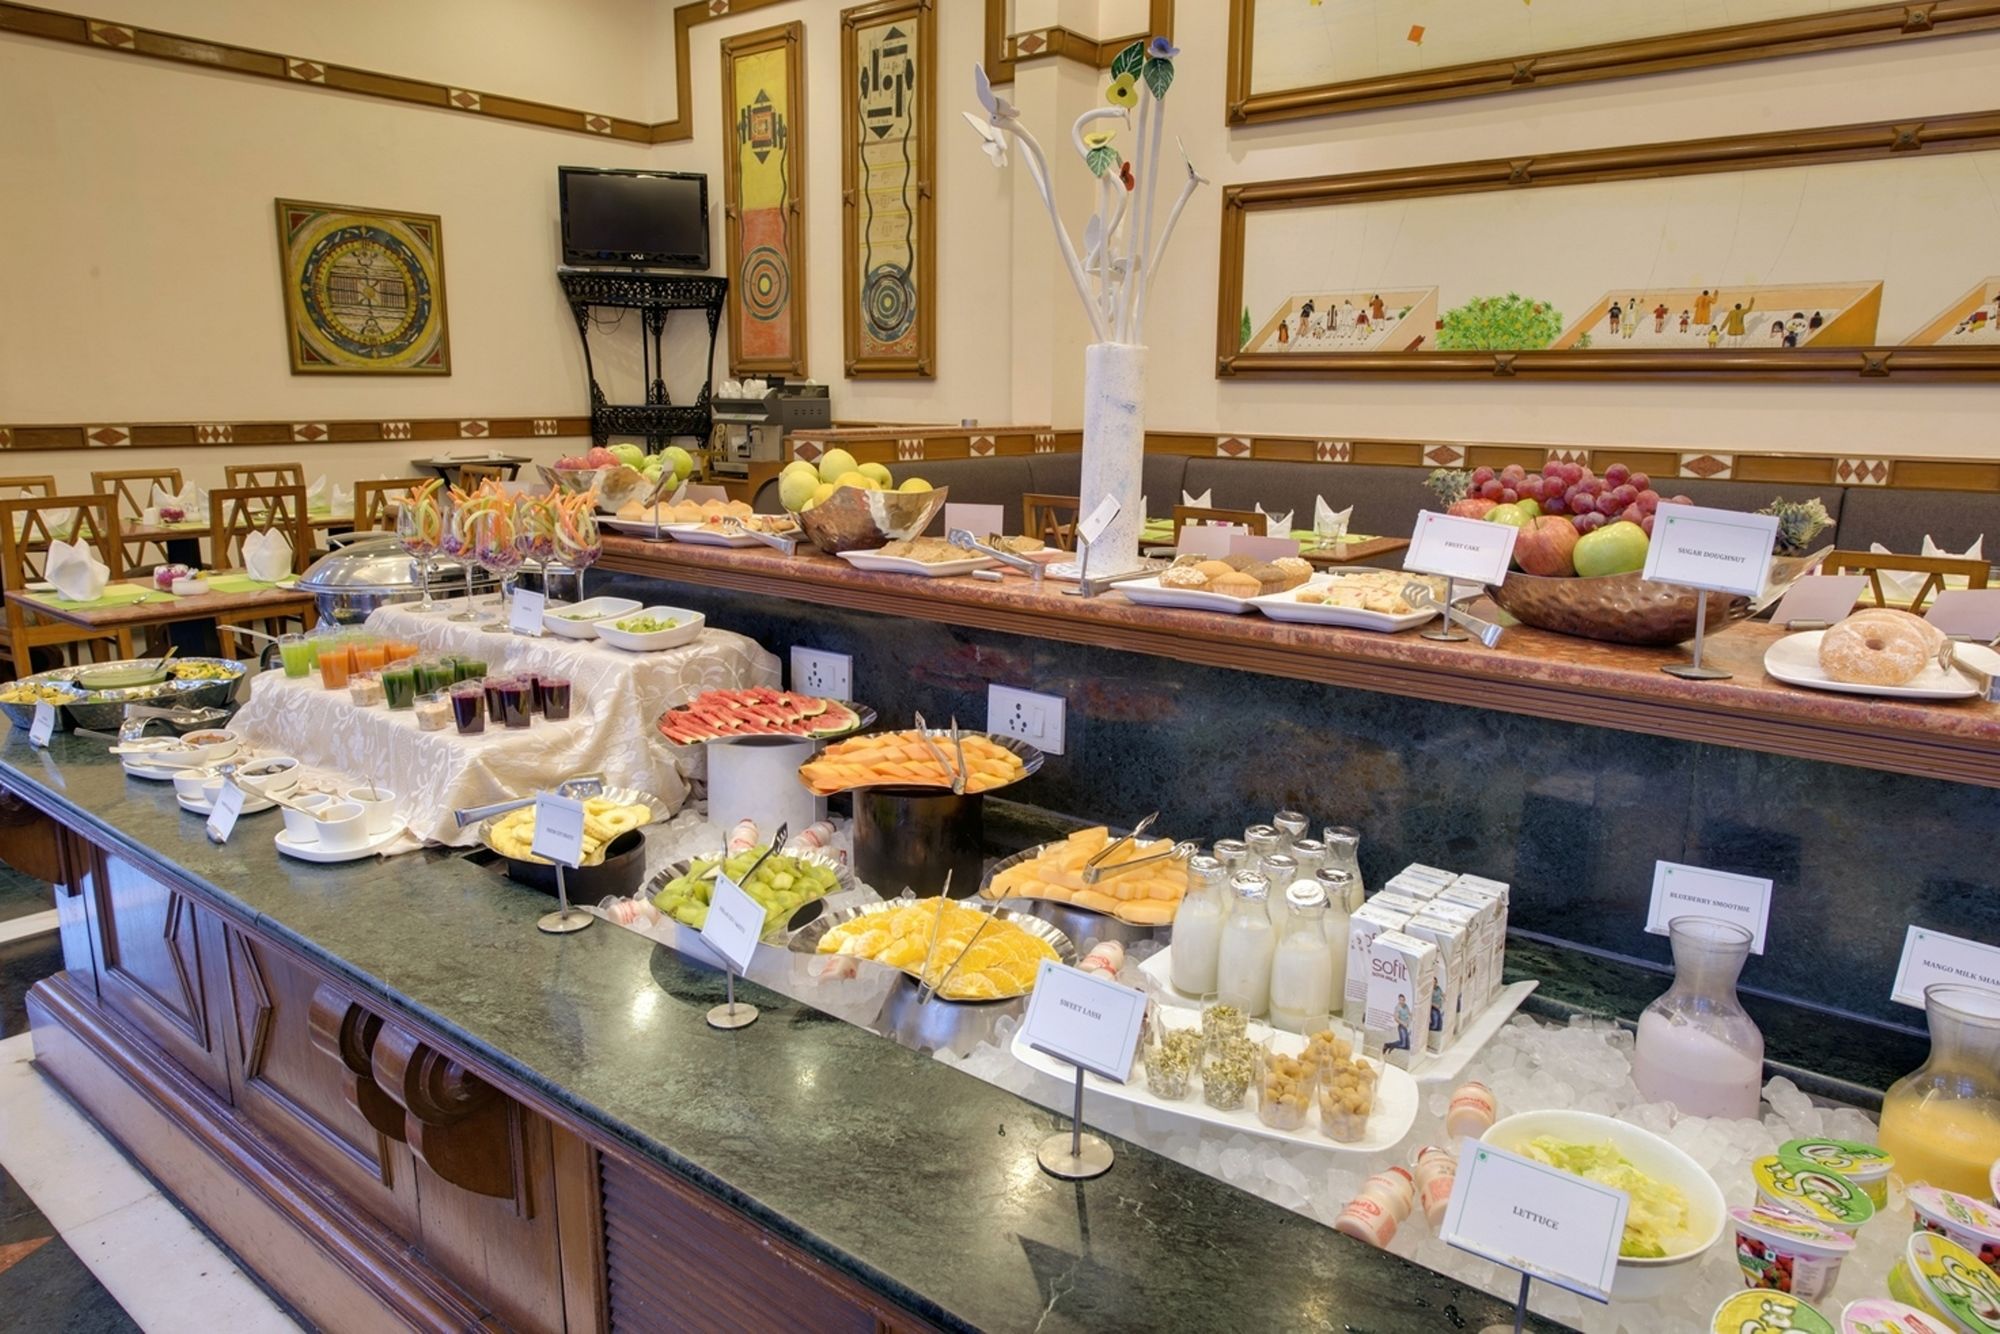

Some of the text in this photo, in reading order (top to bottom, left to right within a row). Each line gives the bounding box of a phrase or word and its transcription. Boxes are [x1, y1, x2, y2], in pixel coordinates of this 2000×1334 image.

[1444, 541, 1480, 552] FRUIT CAKE
[1678, 547, 1745, 563] SUGAR DOUGHNUT
[1670, 892, 1750, 912] BLUEBERRY SMOOTHIE
[1372, 957, 1407, 981] sofit
[1923, 959, 1954, 973] MANGO
[1955, 968, 1976, 980] MILK
[1059, 999, 1101, 1020] SWEET LASSI
[1512, 1205, 1560, 1230] LETTUCE
